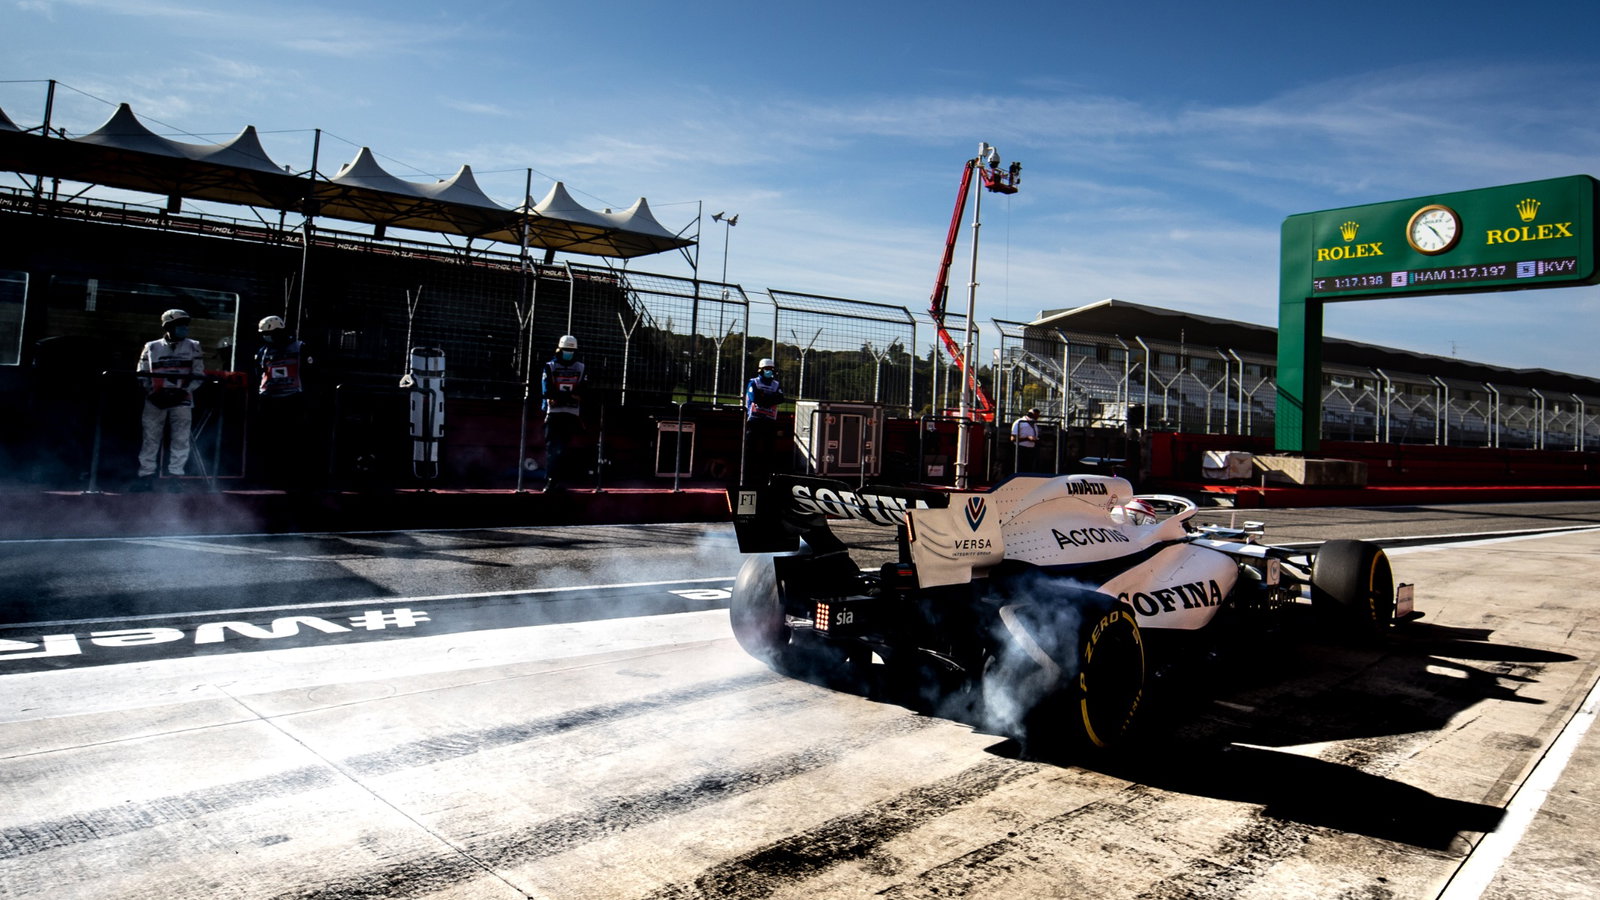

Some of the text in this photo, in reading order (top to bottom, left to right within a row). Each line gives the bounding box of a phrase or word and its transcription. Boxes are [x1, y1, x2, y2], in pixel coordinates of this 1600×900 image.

[1486, 222, 1574, 245] ROLEX
[1316, 242, 1384, 262] ROLEX
[1415, 270, 1447, 281] HAM
[1449, 265, 1506, 279] 1:17.197
[1545, 260, 1576, 272] KVY
[1066, 479, 1108, 495] LAVAZZA
[740, 494, 756, 506] FT
[954, 539, 992, 549] VERSA
[1051, 527, 1130, 550] Acronis
[835, 607, 855, 626] sia
[1084, 610, 1119, 664] ZERO
